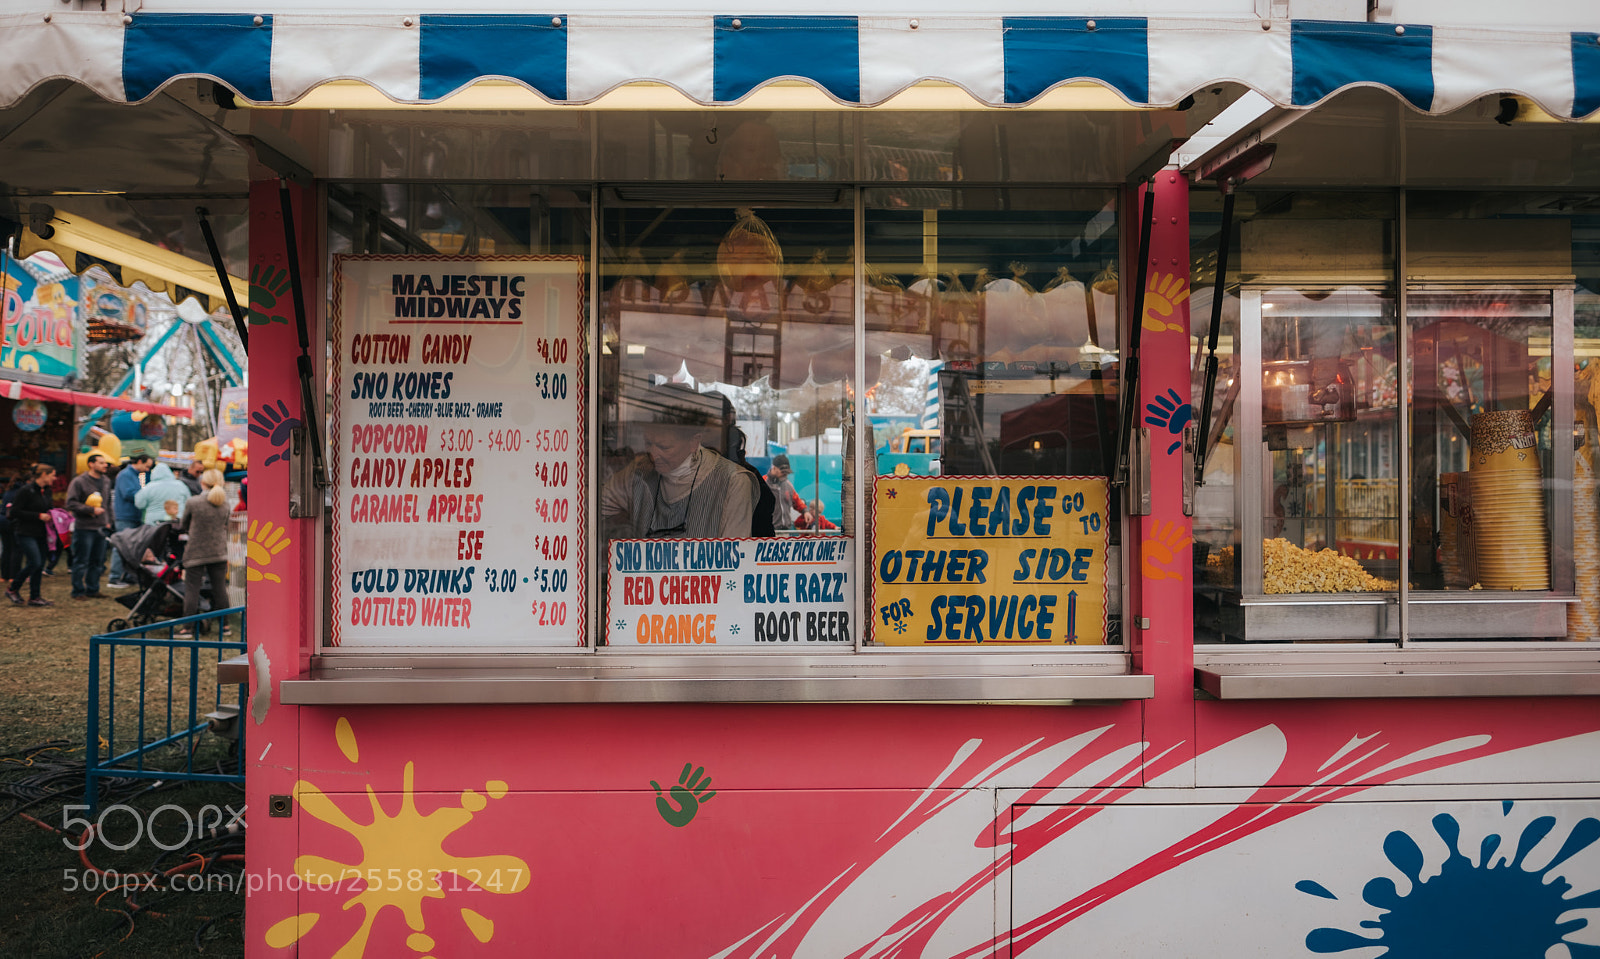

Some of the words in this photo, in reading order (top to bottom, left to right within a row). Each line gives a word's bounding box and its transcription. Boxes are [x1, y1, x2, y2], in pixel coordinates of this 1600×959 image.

[392, 274, 525, 297] MAJESTIC
[1, 289, 74, 348] Pond
[395, 298, 521, 319] MIDWAYS
[352, 334, 410, 364] COTTON
[422, 334, 472, 364] CANDY
[537, 338, 568, 364] $4.00
[351, 372, 388, 400] SNO
[392, 372, 453, 401] KONES
[536, 372, 567, 400] $3.00
[369, 402, 386, 418] ROOT
[387, 402, 404, 418] BEER
[455, 402, 470, 418] RAZZ
[476, 402, 502, 418] ORANGE
[352, 424, 428, 455] POPCORN
[440, 429, 473, 452] $3.00
[488, 429, 521, 452] $4.00
[536, 430, 568, 452] $5.00
[350, 458, 406, 488] CANDY
[410, 458, 474, 488] APPLES
[536, 462, 568, 487] $4.00
[350, 494, 420, 525] CARAMEL
[427, 494, 484, 523] APPLES
[536, 498, 568, 523] $4.00
[926, 486, 1057, 536] PLEASE
[1062, 492, 1084, 514] GO
[1079, 512, 1100, 535] TO
[535, 535, 568, 560] $4.00
[616, 542, 642, 572] SNO
[645, 542, 680, 570] KONE
[754, 542, 792, 562] PLEASE
[792, 542, 816, 562] PICK
[352, 568, 399, 593] COLD
[404, 566, 475, 595] DRINKS
[485, 568, 516, 592] $3.00
[534, 566, 568, 592] $5.00
[880, 550, 988, 584] OTHER
[1013, 548, 1093, 581] SIDE
[624, 576, 654, 605] RED
[659, 575, 722, 605] CHERRY
[744, 573, 790, 604] BLUE
[351, 597, 416, 627] BOTTLED
[421, 597, 472, 629] WATER
[532, 600, 566, 626] $2.00
[754, 612, 801, 642] ROOT
[806, 611, 850, 642] BEER
[880, 598, 914, 626] FOR
[926, 594, 1058, 644] SERVICE
[636, 614, 716, 644] ORANGE
